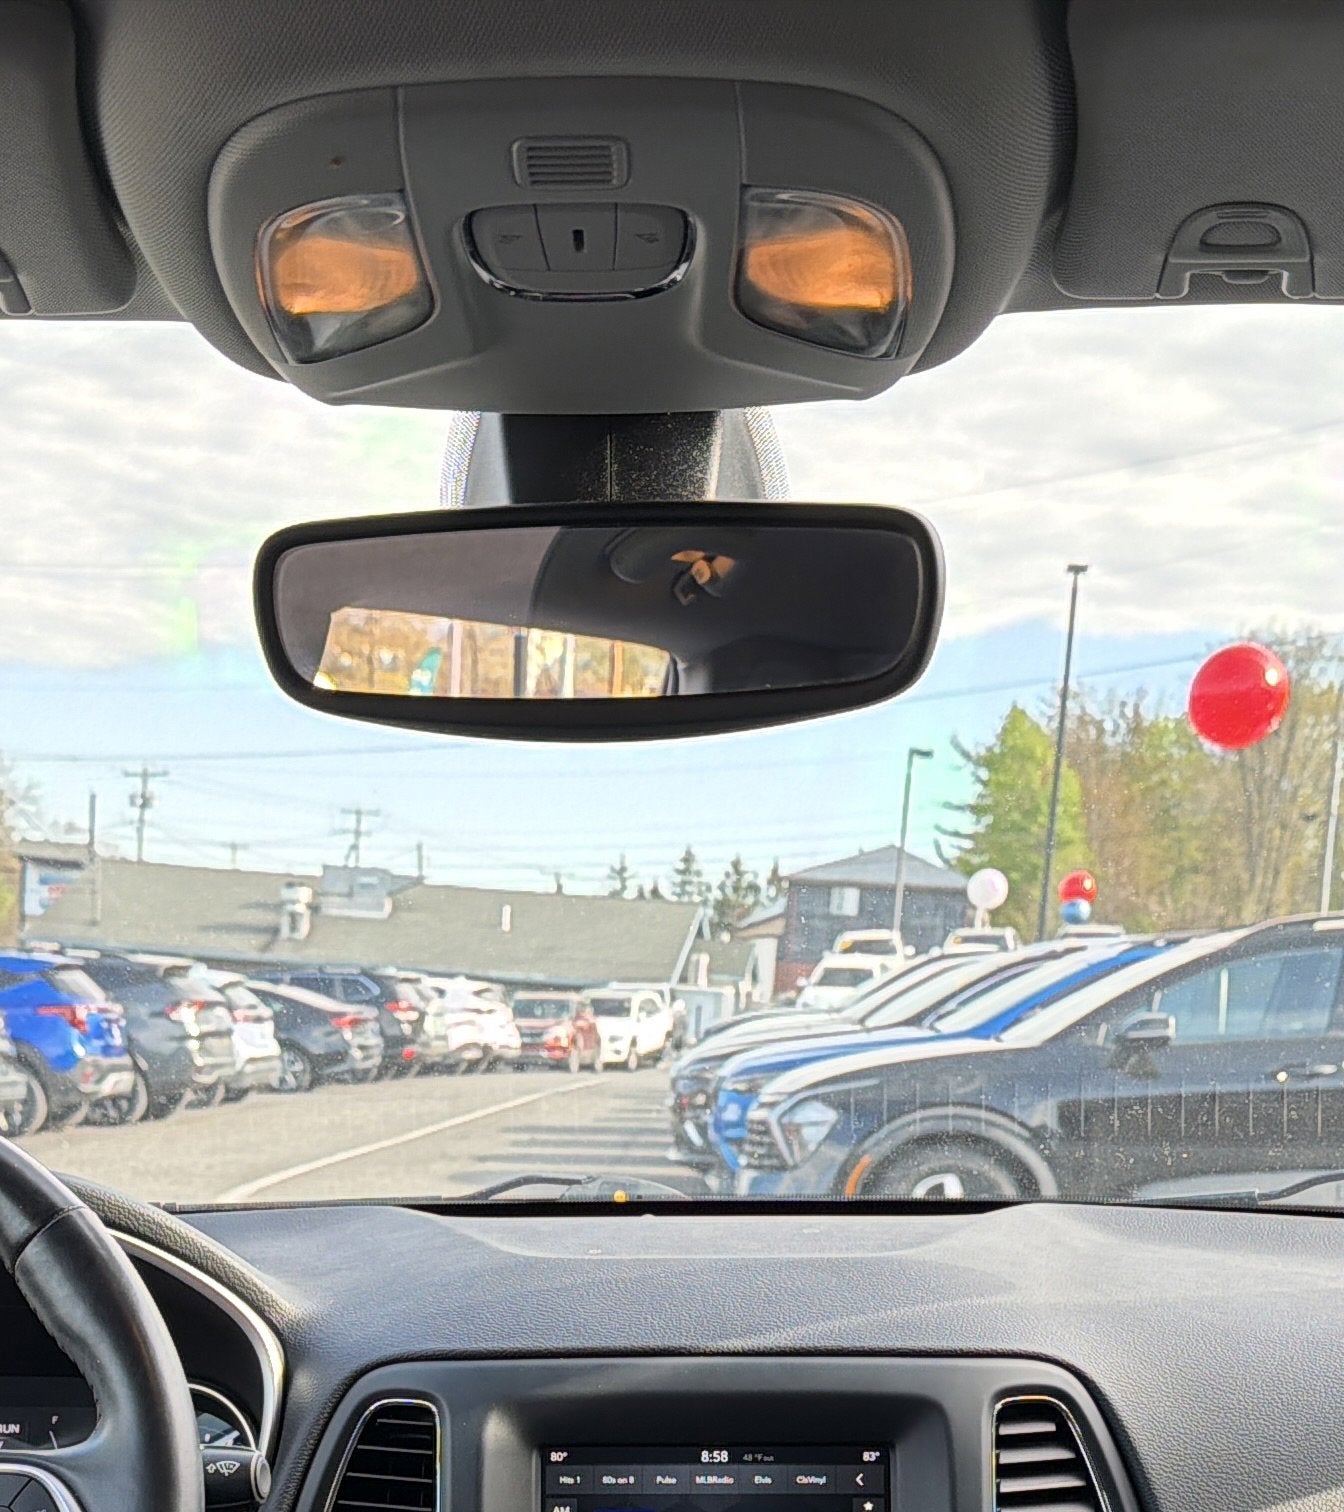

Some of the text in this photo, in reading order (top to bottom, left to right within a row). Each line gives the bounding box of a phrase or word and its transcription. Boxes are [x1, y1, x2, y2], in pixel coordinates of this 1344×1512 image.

[701, 1450, 729, 1462] 8:58
[559, 1475, 574, 1484] Hits
[656, 1475, 677, 1485] Pulse
[754, 1475, 772, 1484] Elvis
